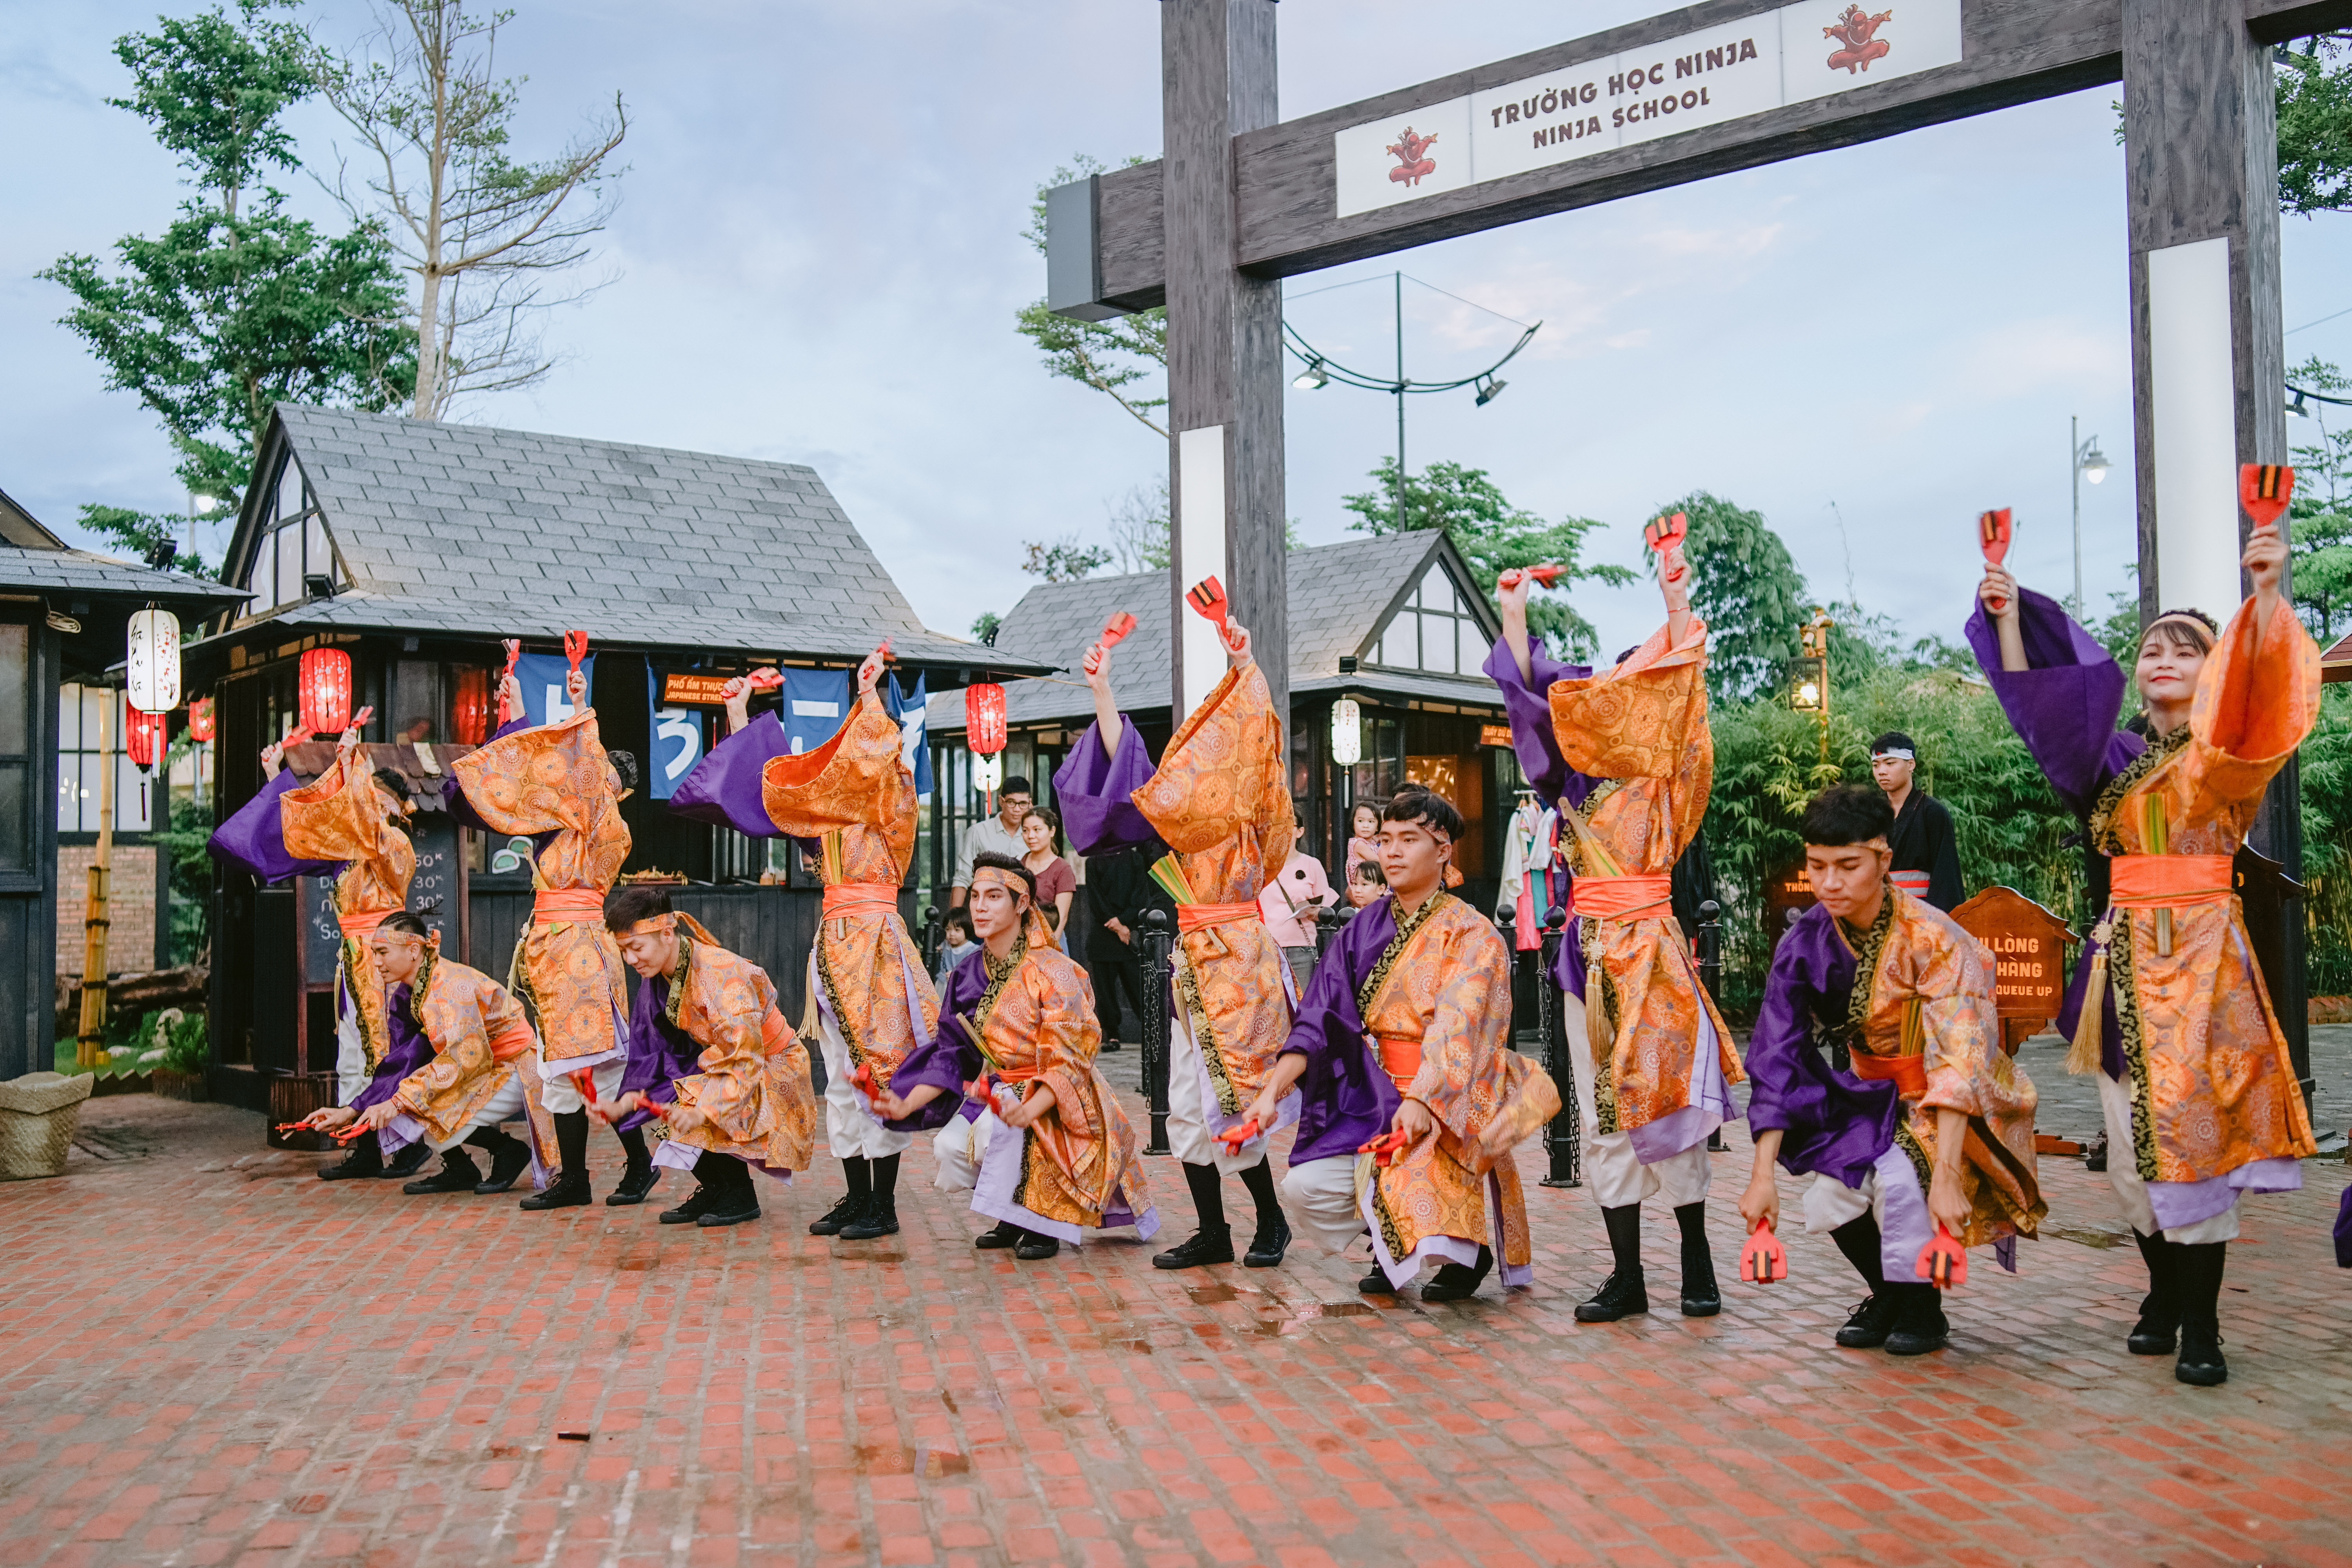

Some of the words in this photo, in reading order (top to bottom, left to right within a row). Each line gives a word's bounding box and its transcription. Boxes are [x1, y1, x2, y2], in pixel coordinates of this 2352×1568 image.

[1491, 82, 1598, 128] TRƯỜNG
[1608, 63, 1664, 96] HỌC
[1675, 38, 1758, 79] NINJA
[1533, 116, 1602, 149] NINJA
[1612, 87, 1710, 128] SCHOOL
[668, 677, 687, 689] PHỐ
[702, 681, 723, 692] THỰC
[667, 691, 701, 700] JAPANESE
[702, 693, 722, 702] STREE
[1994, 932, 2039, 953] LÒNG
[1996, 956, 2042, 978] HÀNG
[1996, 984, 2033, 996] QUEUE
[2037, 986, 2053, 996] UP
